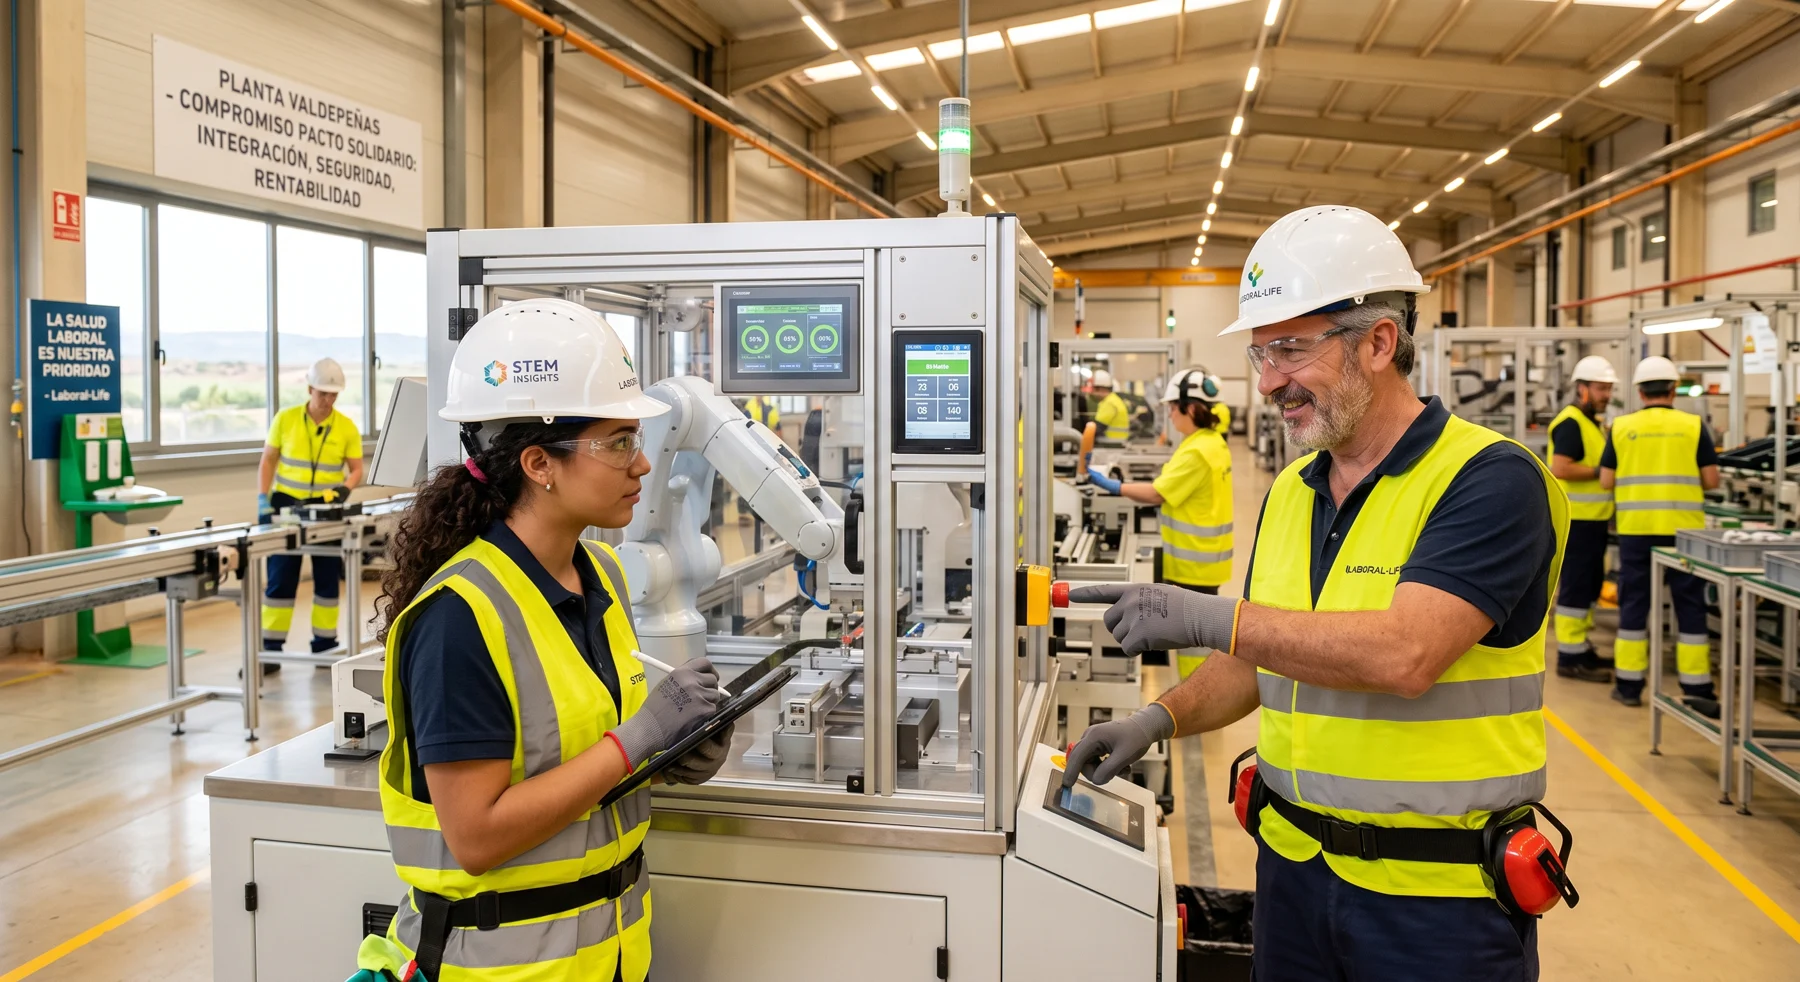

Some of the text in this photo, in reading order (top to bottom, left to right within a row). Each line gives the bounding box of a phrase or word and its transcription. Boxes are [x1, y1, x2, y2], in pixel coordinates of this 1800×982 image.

[219, 69, 381, 135] PLANTA VALDEPEÑAS
[180, 88, 294, 136] COMPROMISO
[299, 123, 344, 151] PACTO
[347, 137, 417, 172] SOLIDARIO:
[198, 124, 395, 193] INTEGRACIÓN, SEGURIDAD,
[255, 168, 361, 208] RENTABILIDAD
[1240, 287, 1282, 304] ORAL-LIFE
[46, 313, 107, 329] LA SALUD
[48, 330, 106, 345] LABORAL
[38, 346, 115, 361] ES NUESTRA
[43, 363, 111, 378] PRIORIDAD
[513, 359, 559, 373] STEM
[513, 373, 559, 383] INSIGHTS
[51, 389, 111, 401] Laboral-Life
